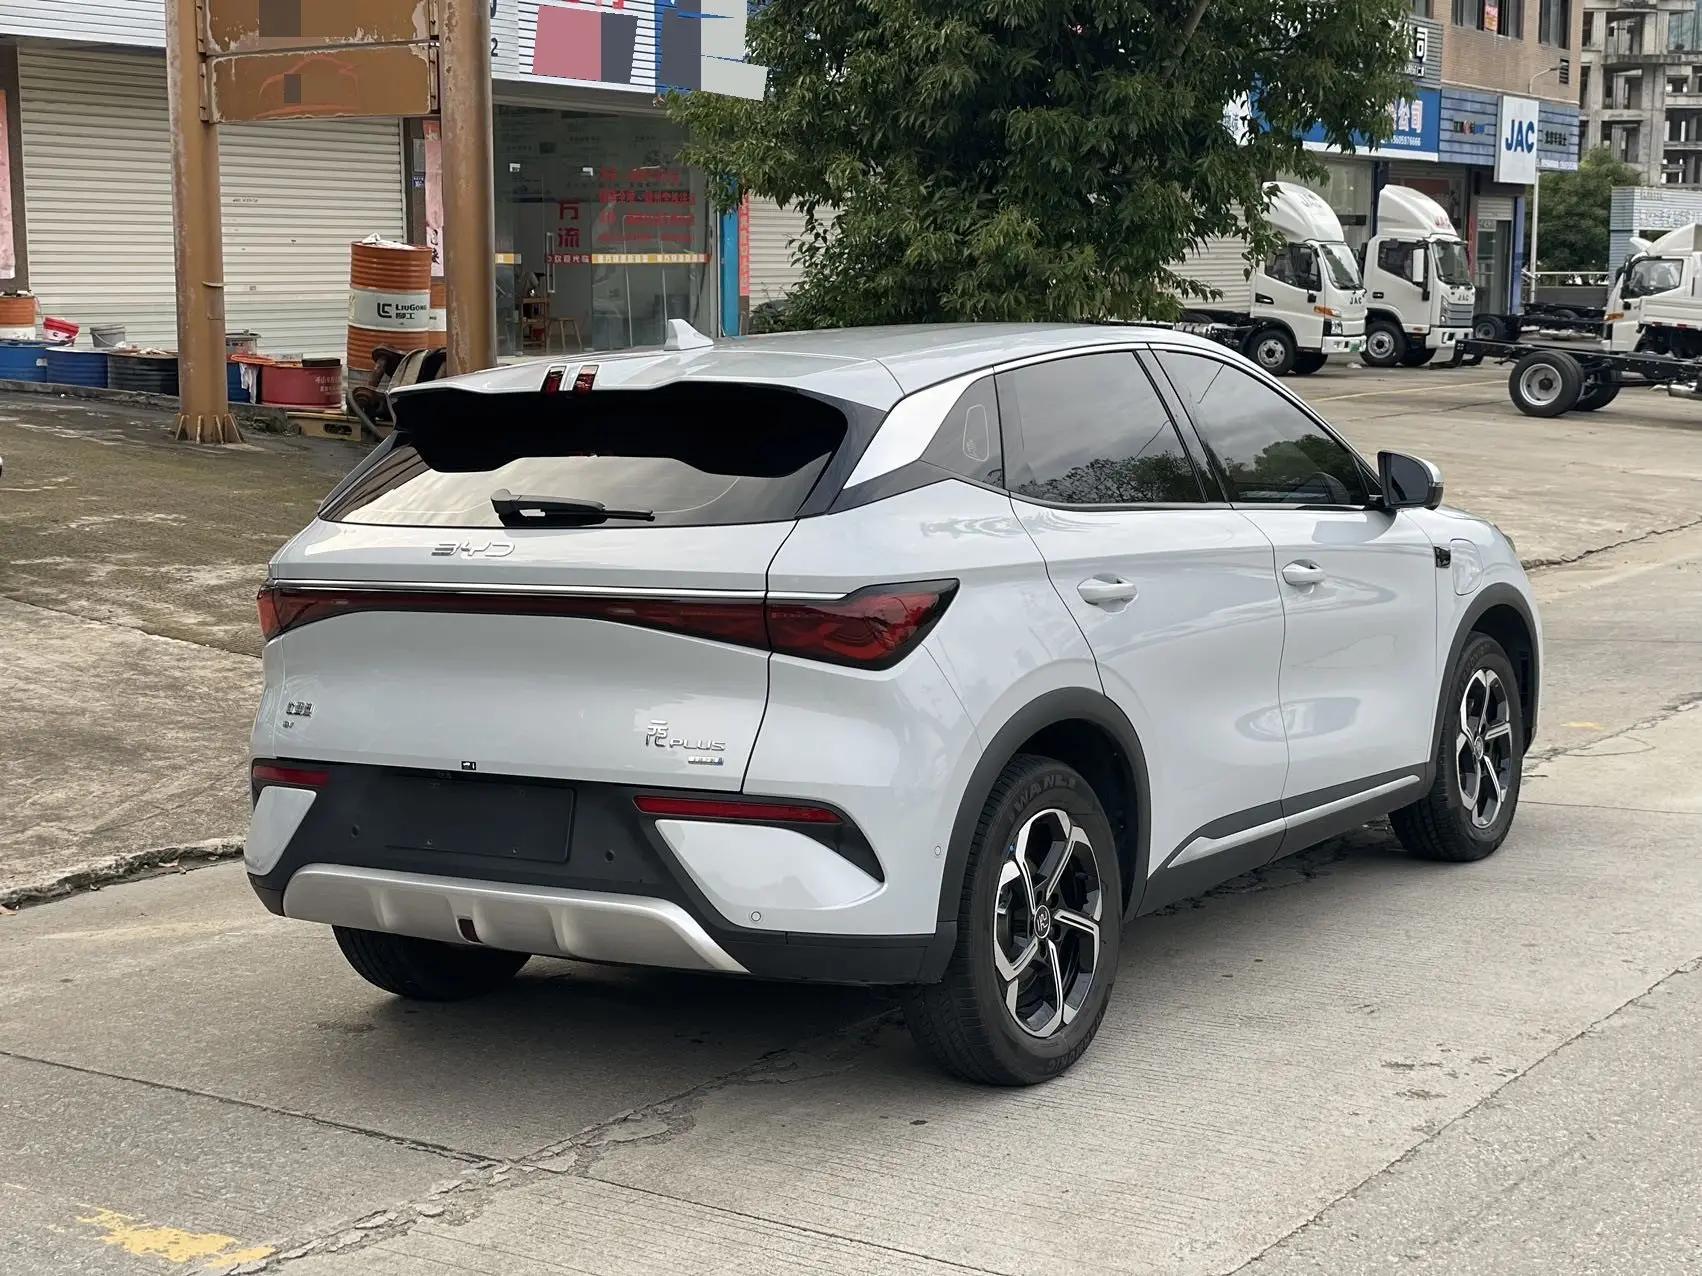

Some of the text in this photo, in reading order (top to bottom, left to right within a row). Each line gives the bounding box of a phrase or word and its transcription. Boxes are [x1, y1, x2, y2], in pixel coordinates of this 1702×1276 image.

[1505, 118, 1535, 154] JAC
[1349, 296, 1362, 305] JAC
[431, 541, 516, 558] BYD
[669, 738, 726, 751] PLUS
